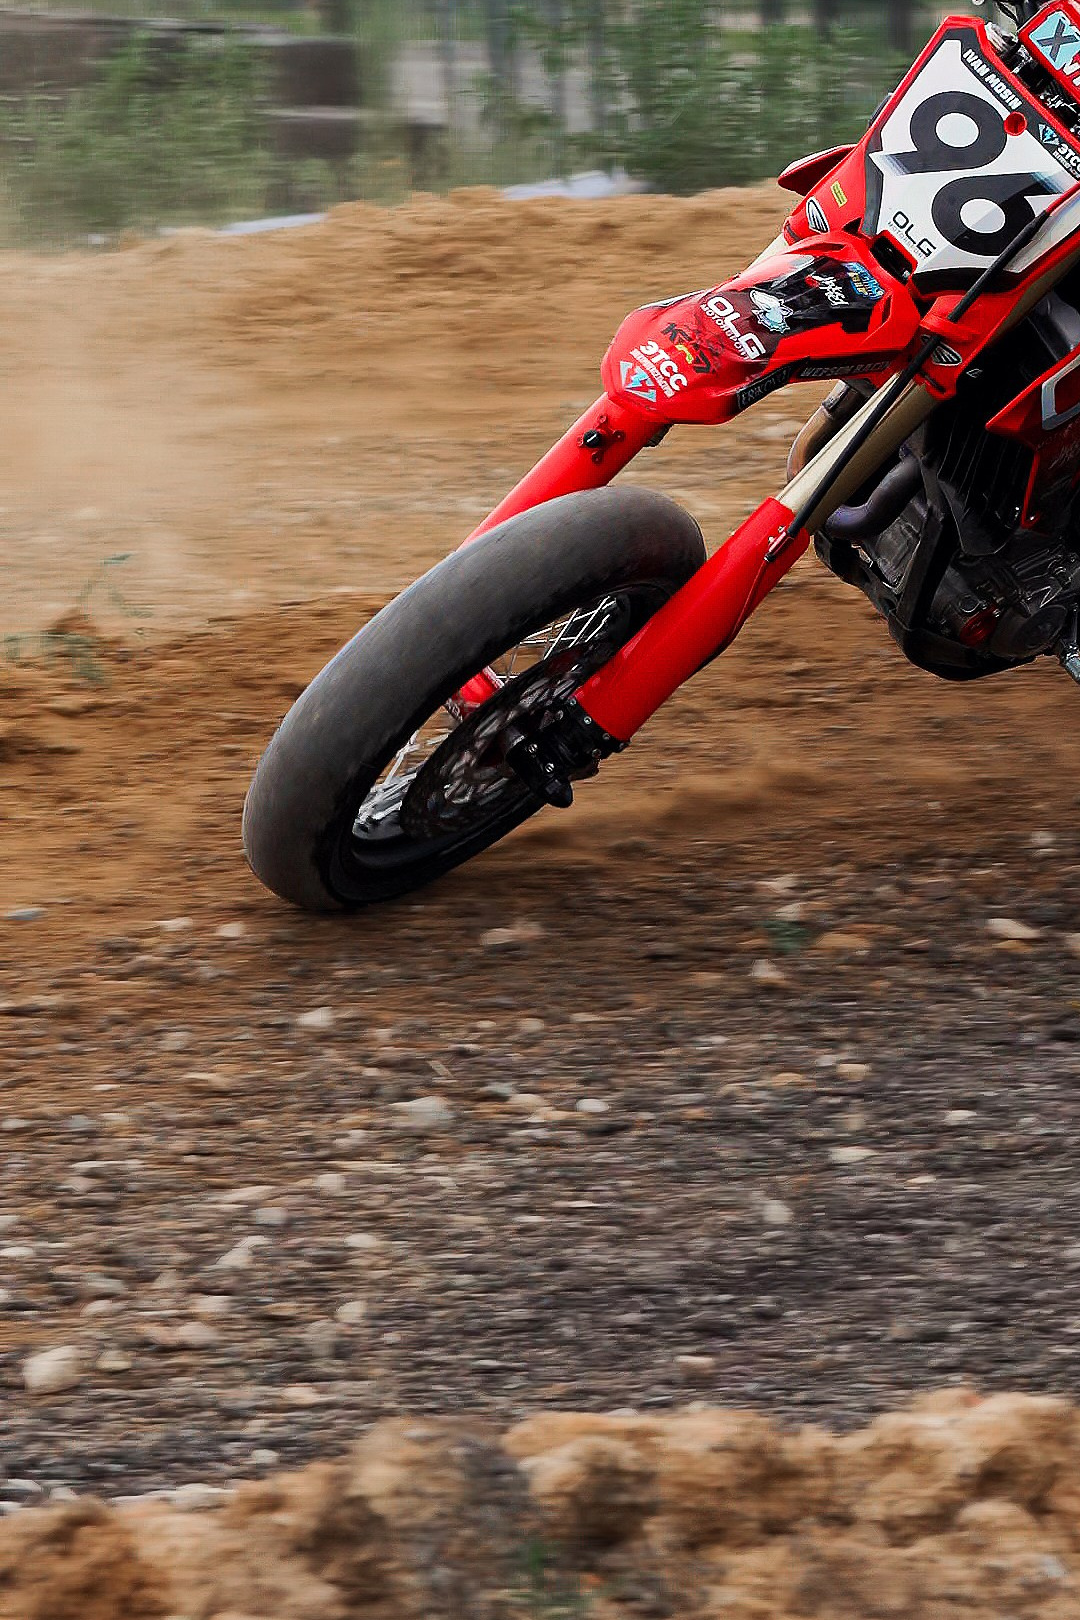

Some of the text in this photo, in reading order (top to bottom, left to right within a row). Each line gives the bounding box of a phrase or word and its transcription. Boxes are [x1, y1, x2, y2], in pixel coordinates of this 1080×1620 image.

[962, 48, 1023, 111] IVAN MOSIN
[886, 91, 1065, 257] 96
[892, 210, 937, 258] OLG
[707, 295, 767, 361] OLG
